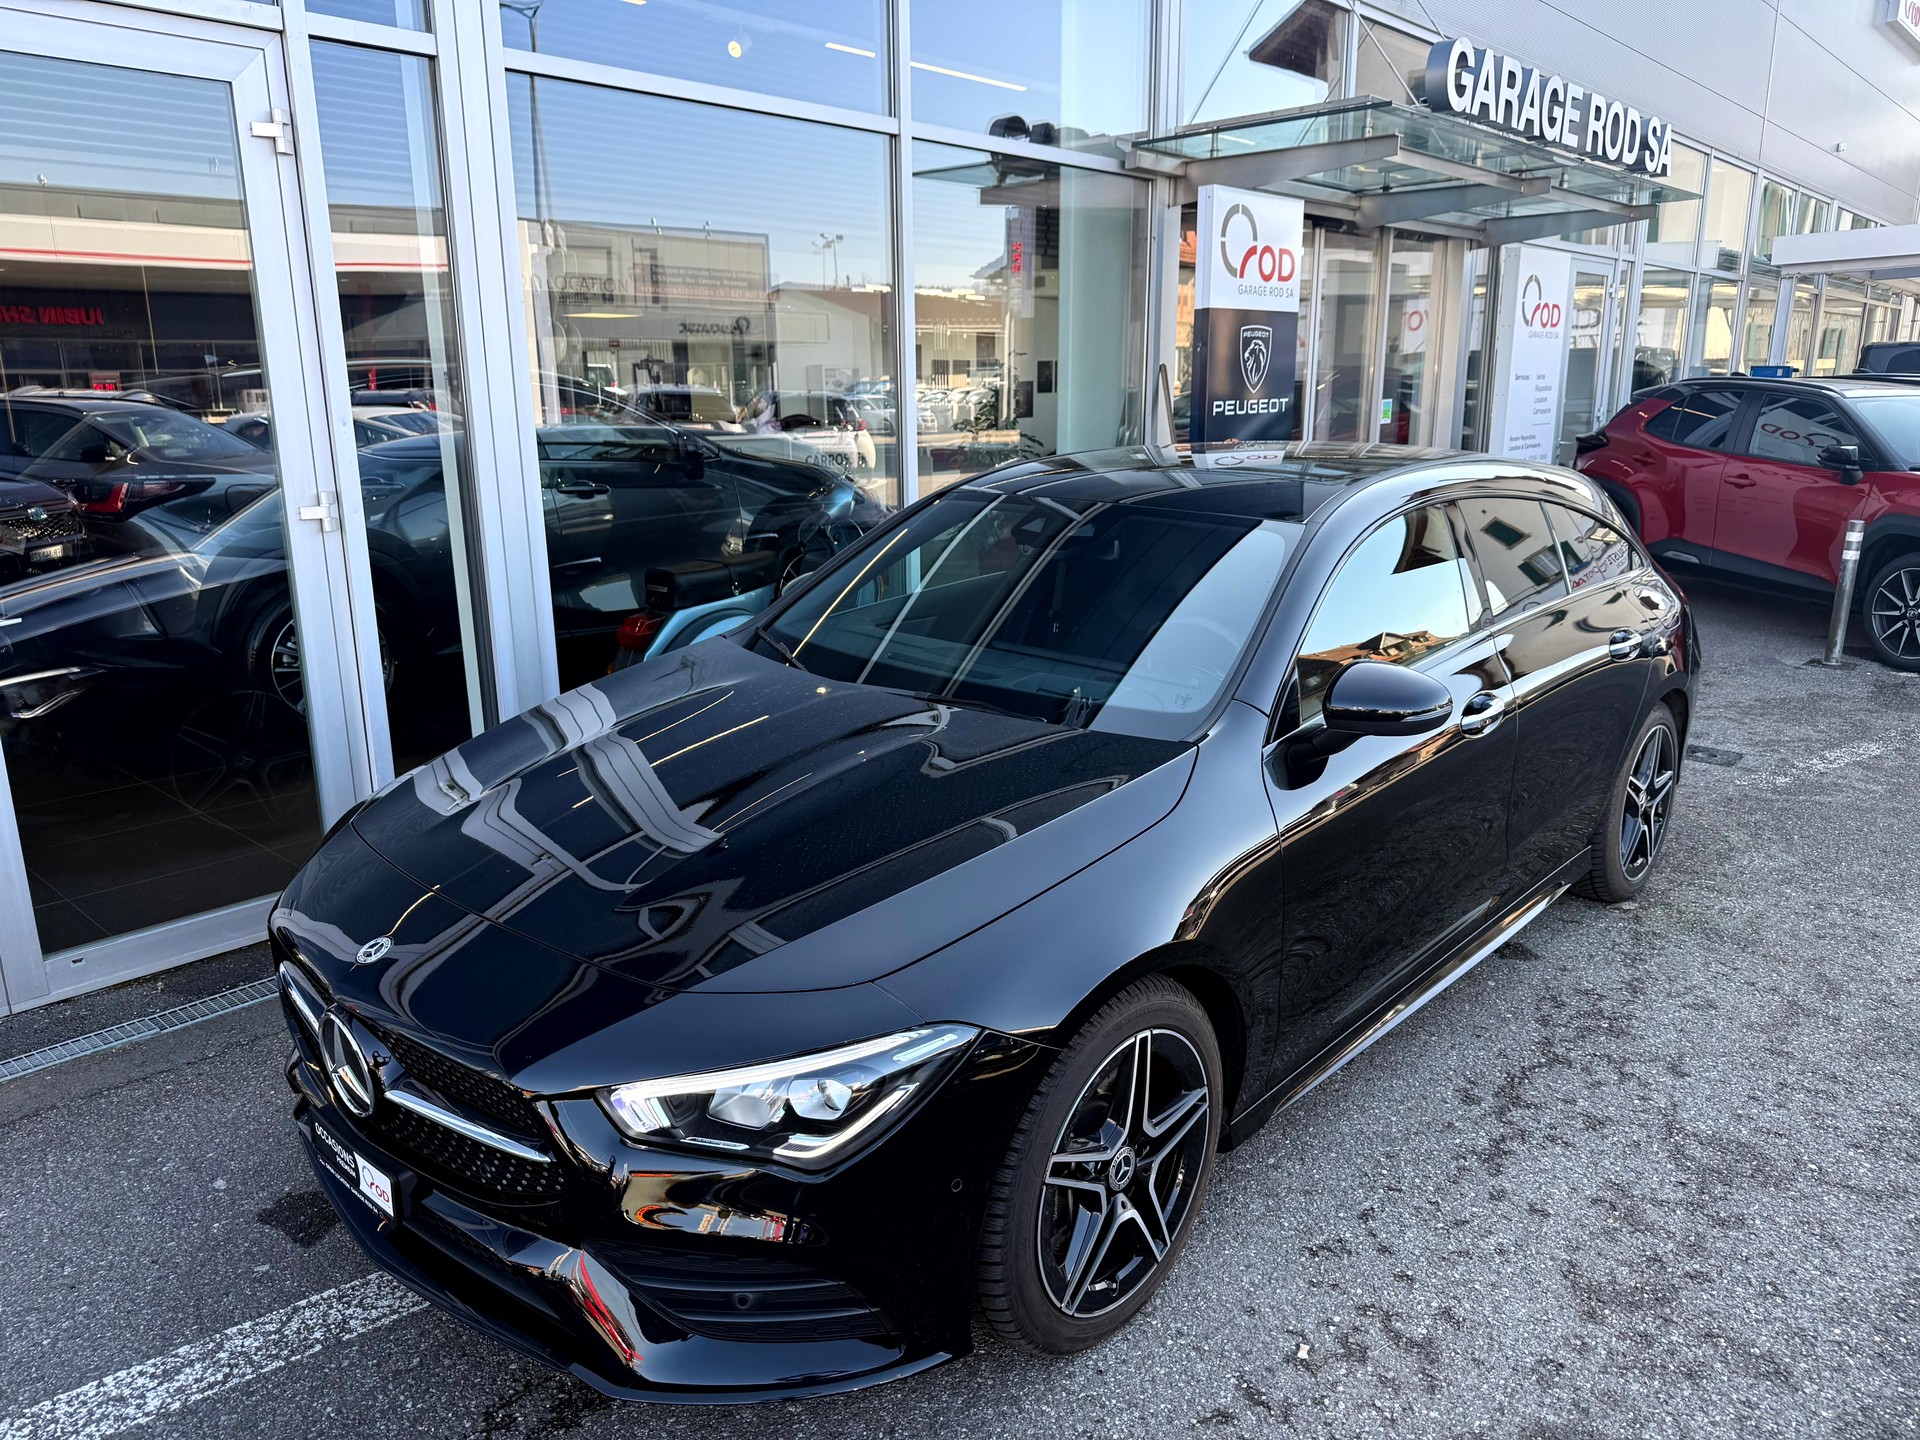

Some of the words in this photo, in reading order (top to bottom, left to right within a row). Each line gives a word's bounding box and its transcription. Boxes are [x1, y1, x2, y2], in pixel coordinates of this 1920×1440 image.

[1447, 37, 1584, 148] GARAGE
[1586, 93, 1641, 166] ROD
[1645, 116, 1672, 177] SA
[1238, 284, 1267, 296] GARAGE
[1269, 286, 1284, 298] ROD
[1286, 287, 1294, 298] SA
[1212, 398, 1289, 416] PEUGEOT
[315, 1122, 355, 1168] OCCASIONS
